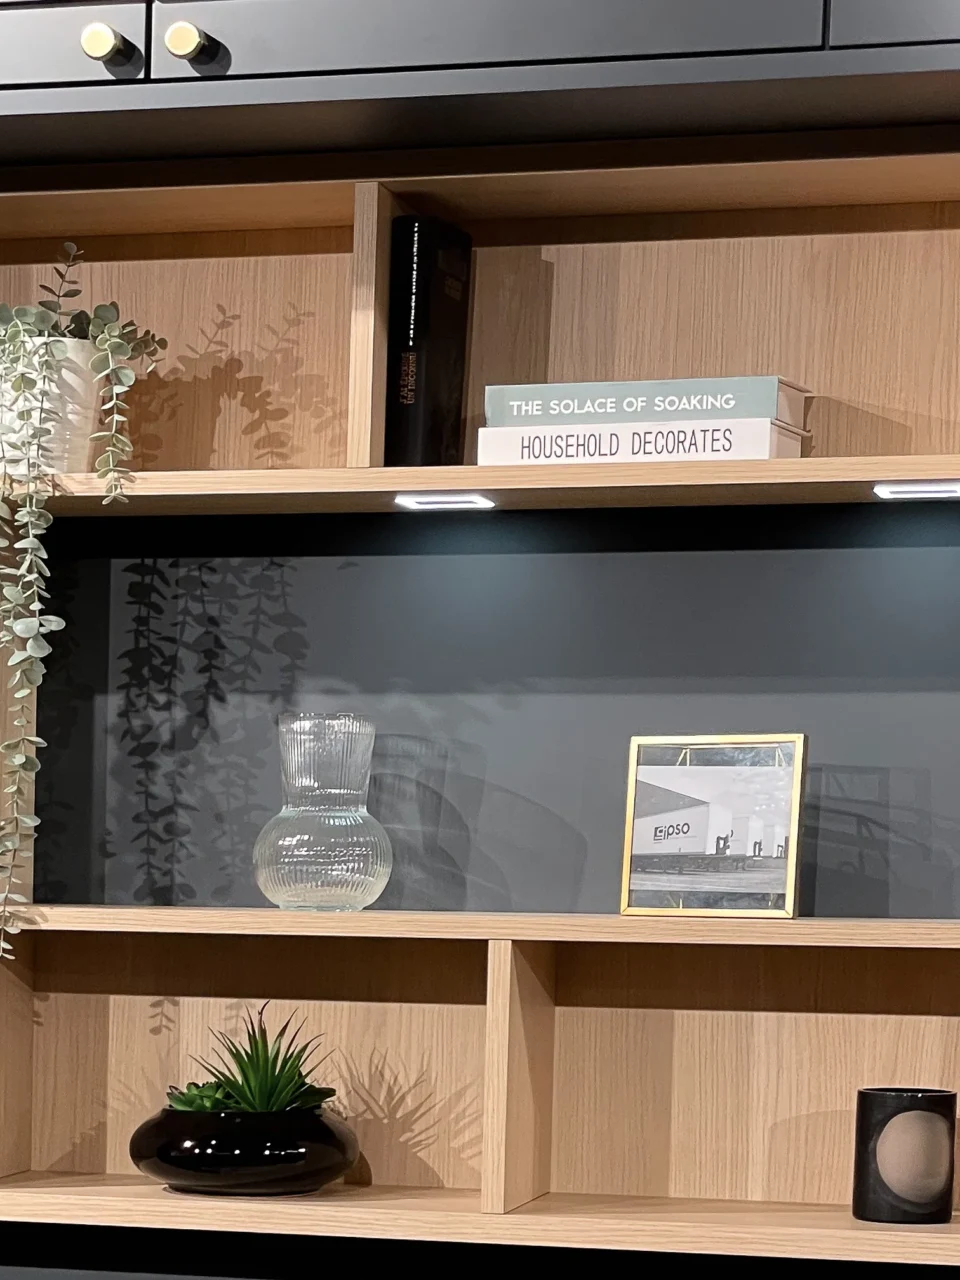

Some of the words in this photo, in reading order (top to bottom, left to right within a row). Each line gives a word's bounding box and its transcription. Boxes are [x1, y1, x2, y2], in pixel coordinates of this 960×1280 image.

[509, 400, 543, 416] THE
[549, 398, 617, 414] SOLACE
[622, 396, 648, 412] OF
[653, 393, 736, 412] SOAKING
[520, 432, 620, 460] HOUSEHOLD
[631, 428, 733, 456] DECORATES
